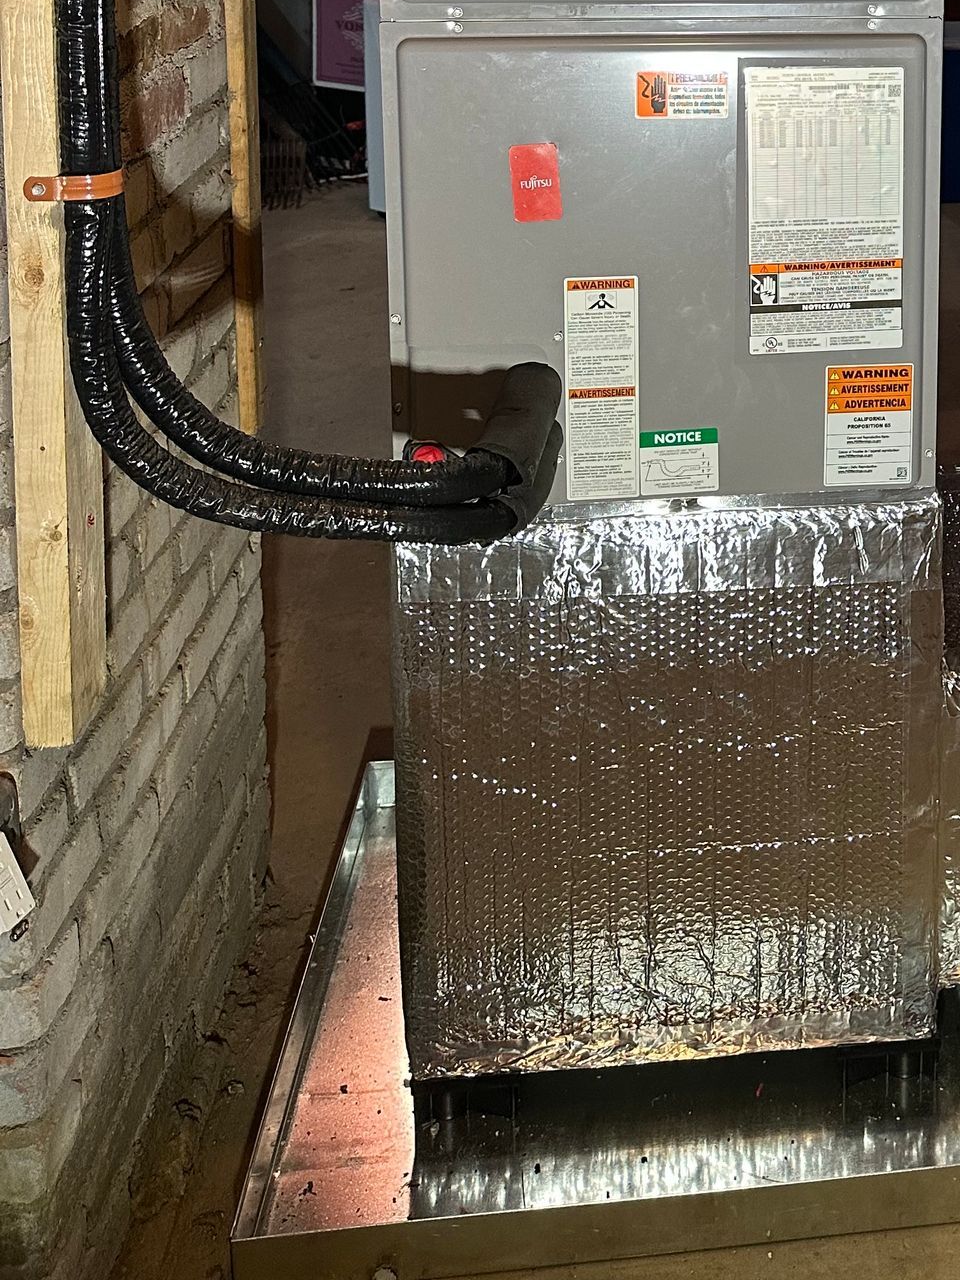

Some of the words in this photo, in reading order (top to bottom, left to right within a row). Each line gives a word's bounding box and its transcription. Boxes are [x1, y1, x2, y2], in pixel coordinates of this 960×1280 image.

[520, 175, 552, 190] FUJITSU
[784, 260, 896, 271] WARNING/AVERTISSEMENT
[580, 279, 631, 290] WARNING
[802, 302, 851, 311] NOTICE/AVIS
[842, 368, 909, 379] WARNING
[579, 388, 635, 398] AVERTISSEMENT
[841, 383, 909, 394] AVERTISSEMENT
[844, 398, 906, 409] ADVERTENCIA
[654, 431, 702, 444] NOTICE
